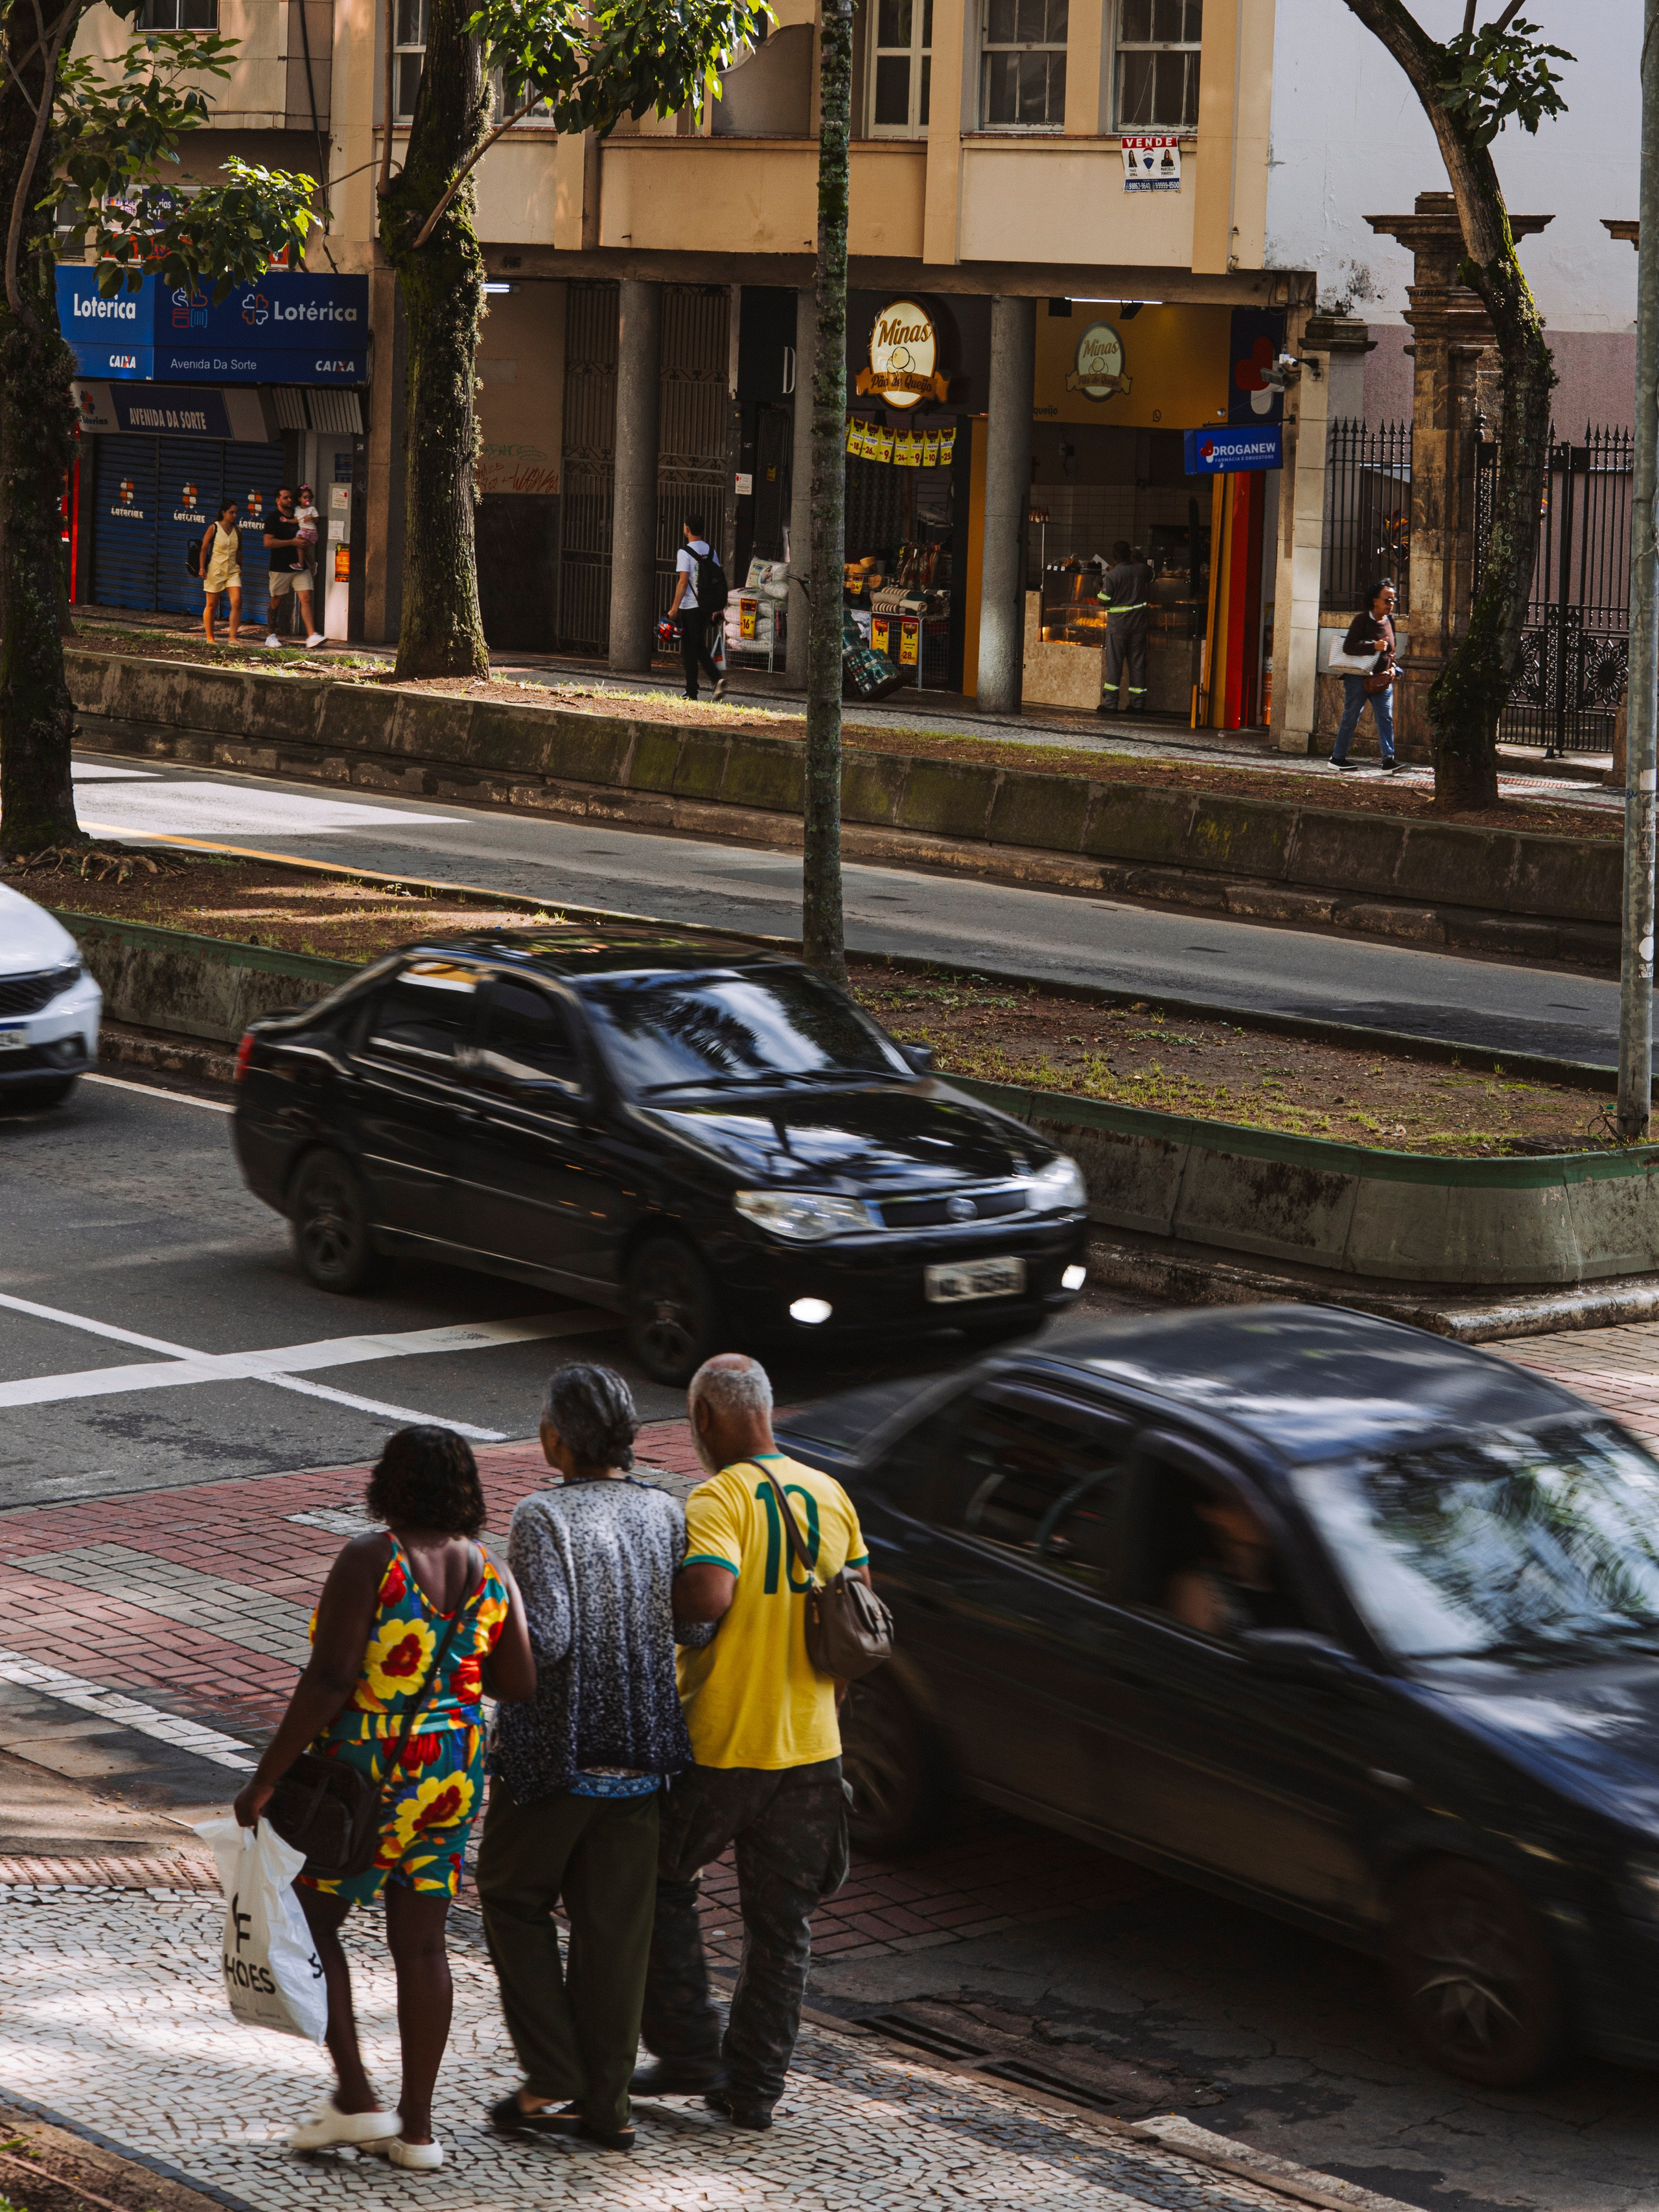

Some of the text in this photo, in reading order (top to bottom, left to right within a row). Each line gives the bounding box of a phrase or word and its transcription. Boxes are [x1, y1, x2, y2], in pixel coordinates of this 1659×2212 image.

[1126, 138, 1172, 147] VENDE
[274, 301, 356, 321] Lotérica
[878, 318, 932, 347] Minas
[1083, 338, 1120, 358] Minas
[110, 355, 135, 368] CAIXA
[170, 359, 257, 369] Avenida Da Sorte
[316, 360, 354, 372] CAIXA
[871, 374, 932, 393] Pão de Queijo
[1078, 376, 1090, 385] Pão
[130, 408, 207, 430] AVENIDA DA SORTE
[1213, 443, 1275, 456] DROGANEW
[754, 1481, 820, 1594] 10
[224, 1953, 275, 1994] HOES
